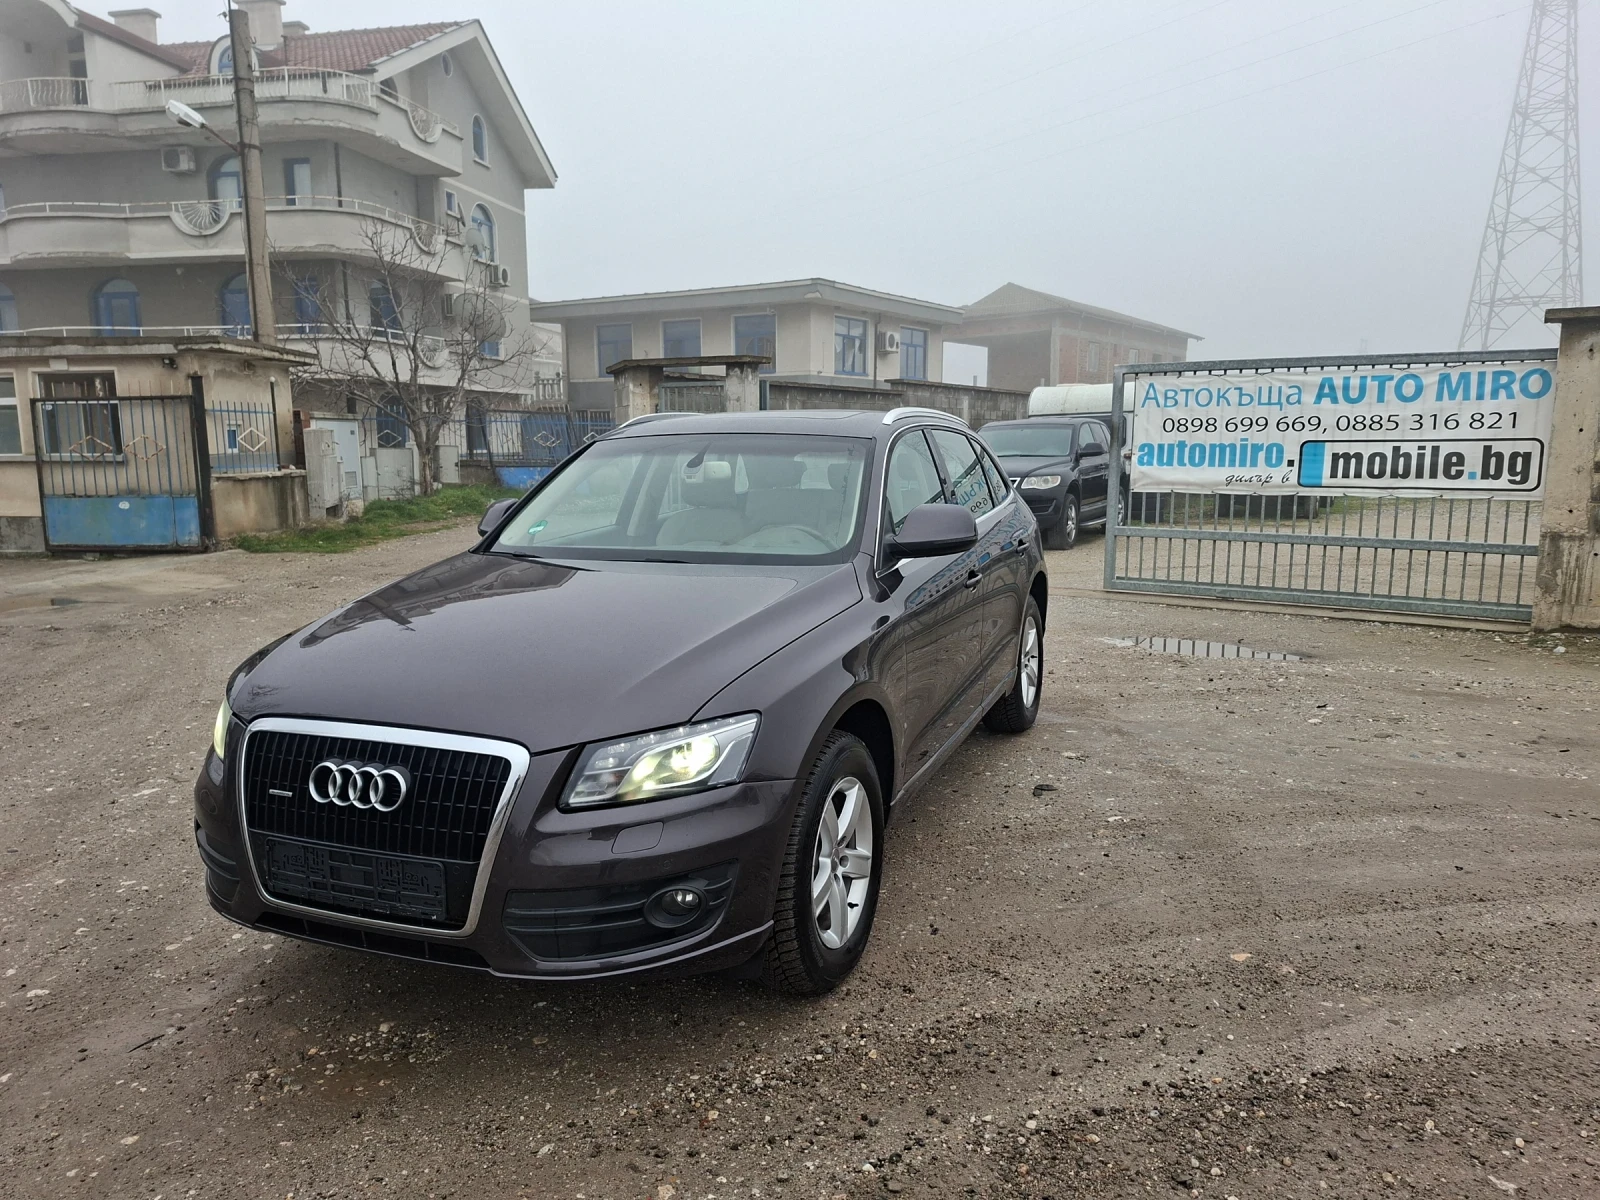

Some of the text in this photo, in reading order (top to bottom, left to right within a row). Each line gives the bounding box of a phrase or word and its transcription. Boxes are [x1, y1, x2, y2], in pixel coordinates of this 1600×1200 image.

[1141, 367, 1553, 411] Автокъща AUTO MIRO
[1162, 411, 1518, 434] 0898 699 669, 0885 316 821
[1137, 438, 1532, 485] automiro. mobile.bg
